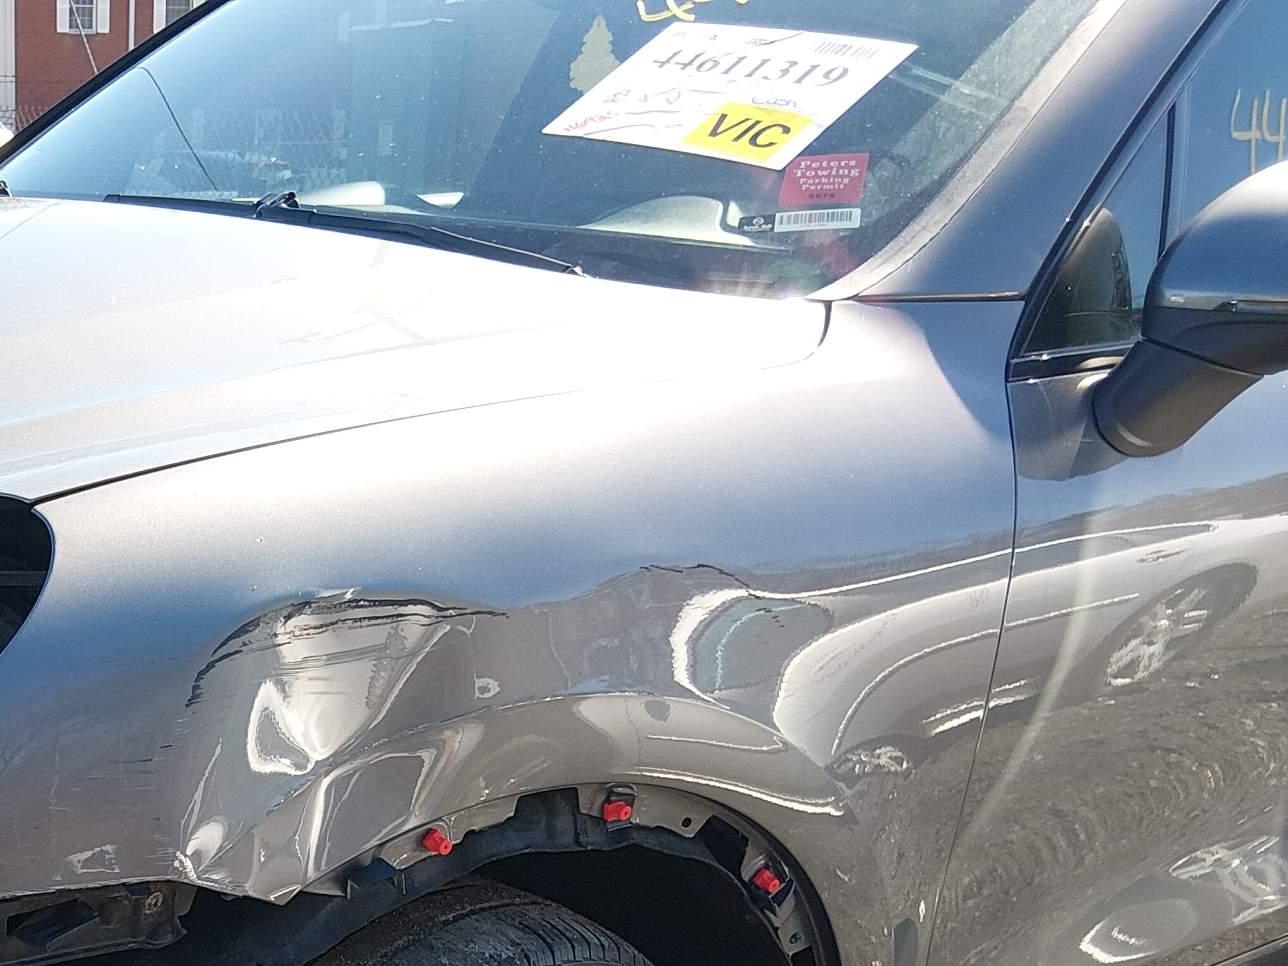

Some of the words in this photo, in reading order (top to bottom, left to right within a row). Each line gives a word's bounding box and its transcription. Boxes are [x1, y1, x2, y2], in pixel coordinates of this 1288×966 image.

[652, 49, 850, 87] 44611319
[707, 112, 792, 149] VIC
[799, 159, 857, 169] Peters
[793, 168, 861, 178] Towing
[799, 177, 851, 185] Parking
[801, 183, 845, 191] Permit
